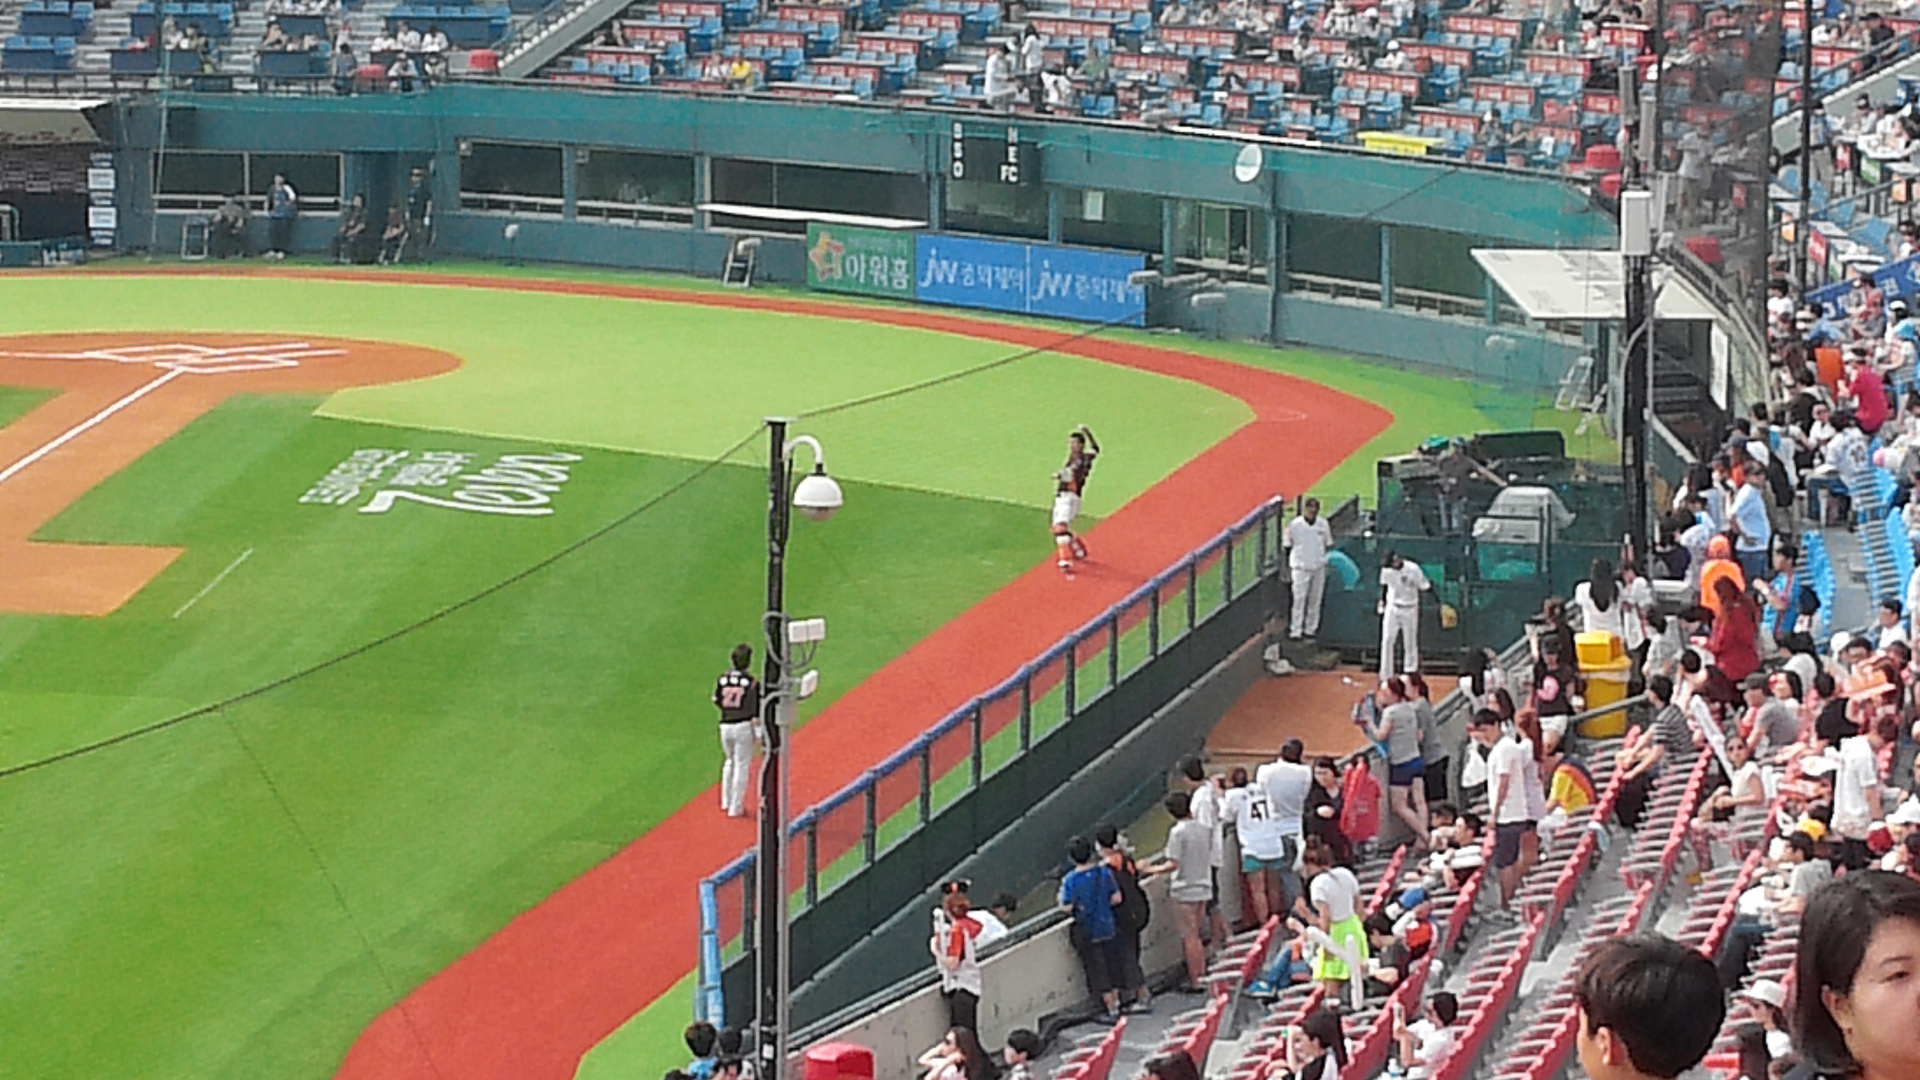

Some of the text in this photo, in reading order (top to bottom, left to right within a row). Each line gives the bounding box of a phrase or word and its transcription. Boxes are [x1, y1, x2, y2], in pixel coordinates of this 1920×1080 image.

[1007, 146, 1018, 163] E
[1000, 164, 1018, 182] FC
[845, 253, 909, 289] 아워홈
[721, 686, 744, 708] 27
[1251, 799, 1270, 821] 47
